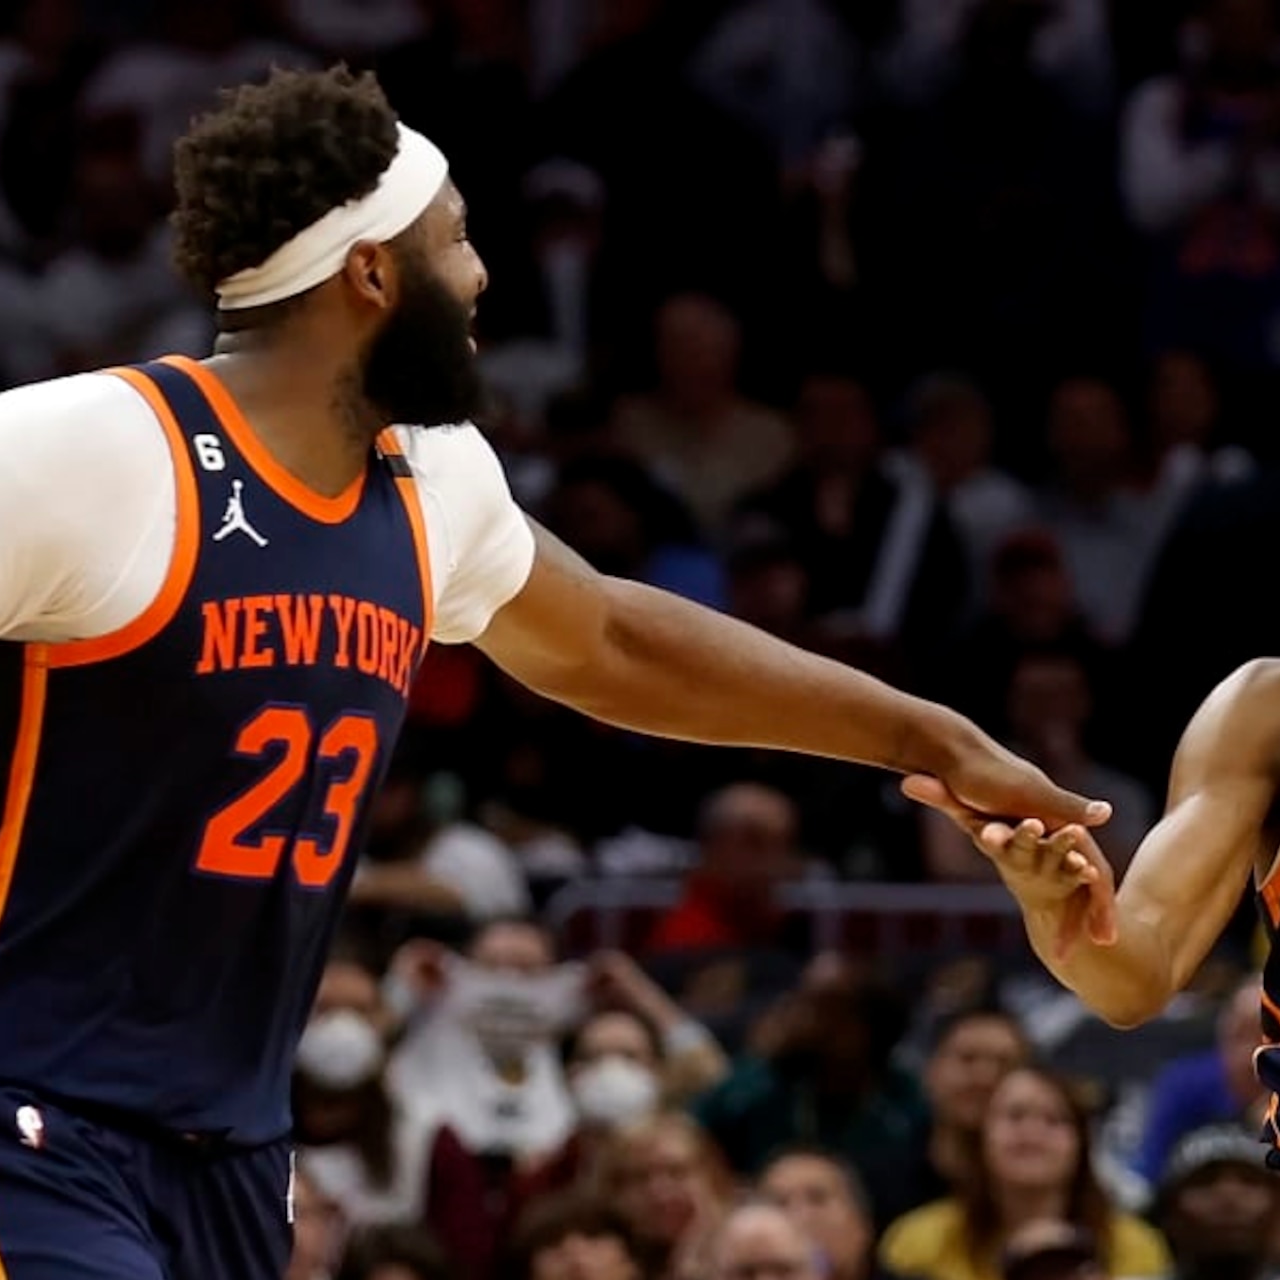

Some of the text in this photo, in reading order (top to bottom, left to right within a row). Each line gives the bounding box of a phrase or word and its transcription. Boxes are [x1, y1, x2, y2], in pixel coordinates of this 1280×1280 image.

[193, 433, 226, 471] 6
[195, 593, 420, 697] NEW YORK
[195, 706, 379, 888] 23
